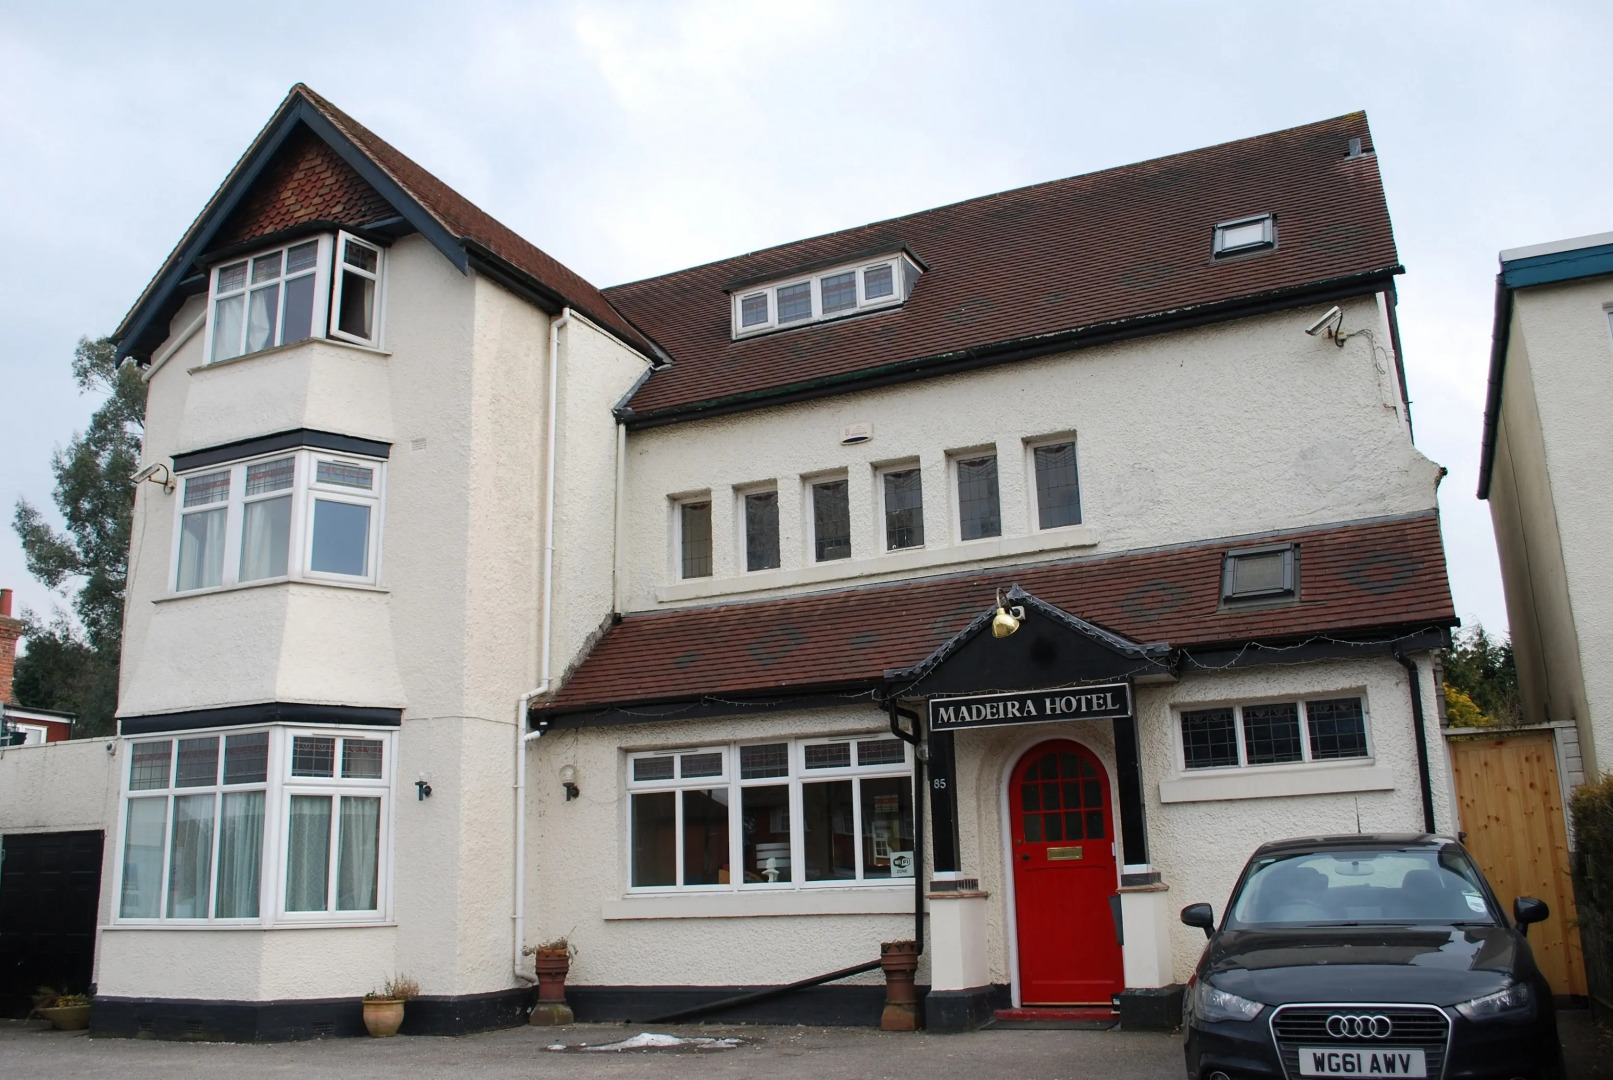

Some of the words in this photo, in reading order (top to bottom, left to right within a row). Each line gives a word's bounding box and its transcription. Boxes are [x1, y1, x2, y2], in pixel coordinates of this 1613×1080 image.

[937, 700, 1038, 724] MADEIRA
[1044, 692, 1120, 714] HOTEL
[933, 778, 946, 789] 85
[1312, 1052, 1362, 1073] WG61
[1369, 1053, 1411, 1074] AWV
